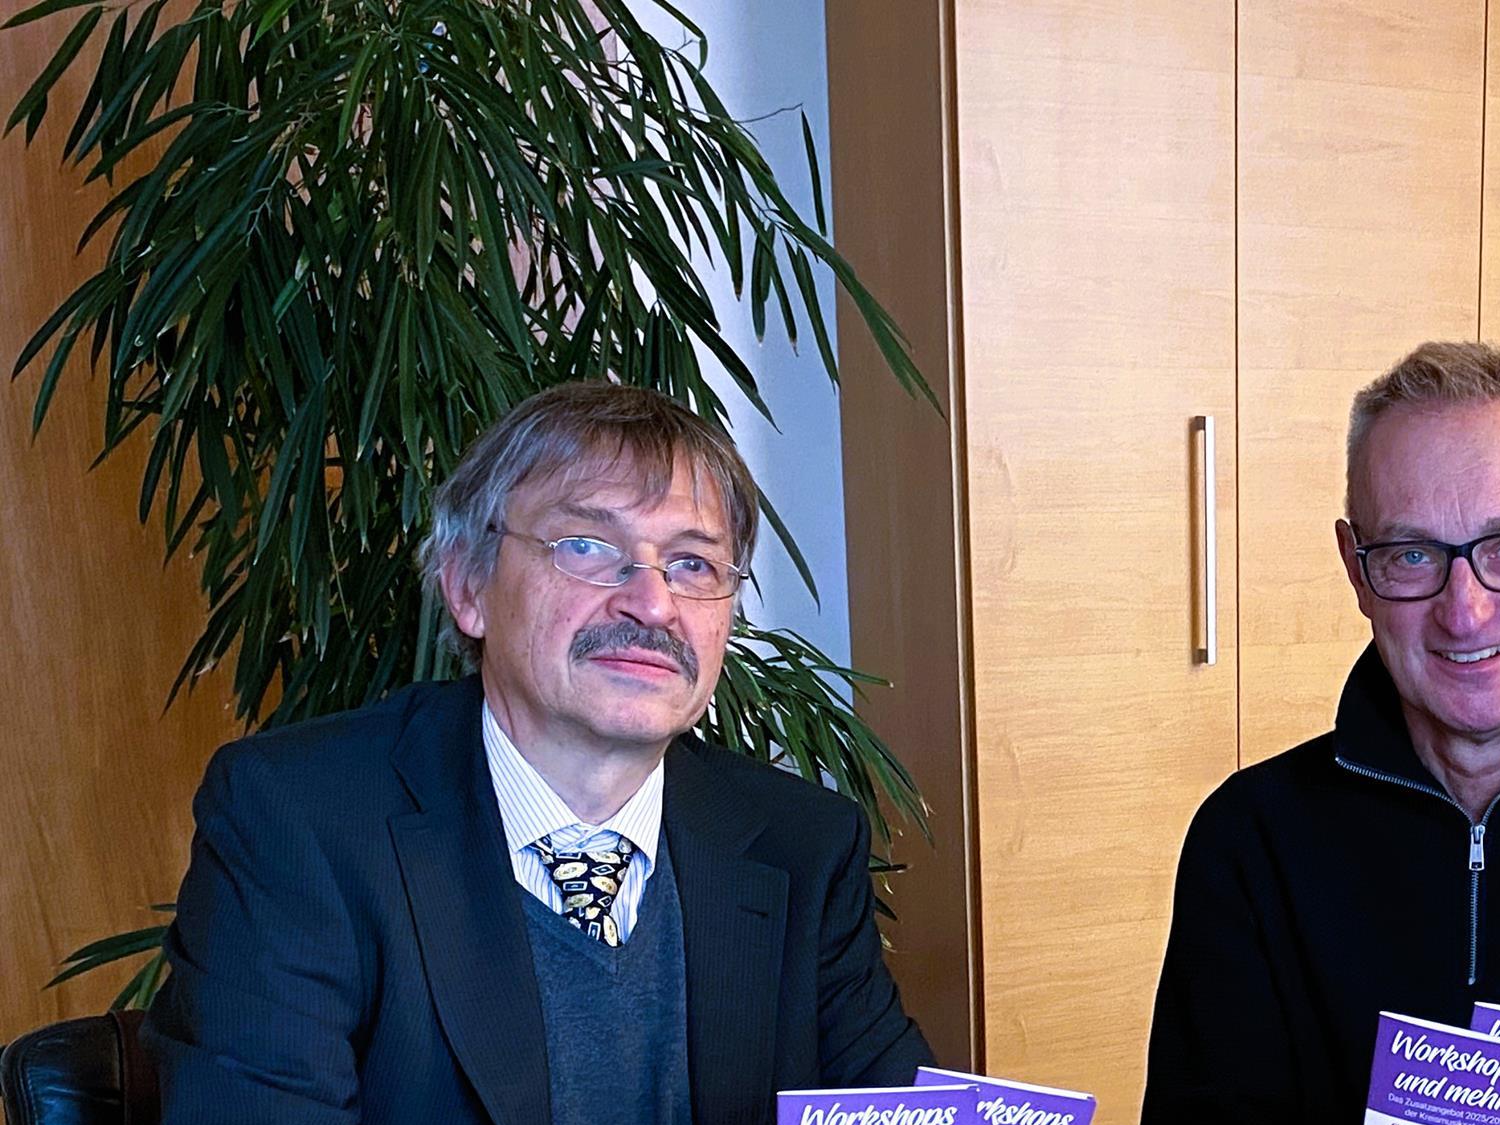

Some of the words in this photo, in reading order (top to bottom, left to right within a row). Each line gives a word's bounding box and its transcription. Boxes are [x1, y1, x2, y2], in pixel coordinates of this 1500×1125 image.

[1393, 1072, 1446, 1101] und
[1388, 1093, 1404, 1105] Das
[1405, 1097, 1464, 1118] Zusatzangebot
[1404, 1108, 1418, 1118] der
